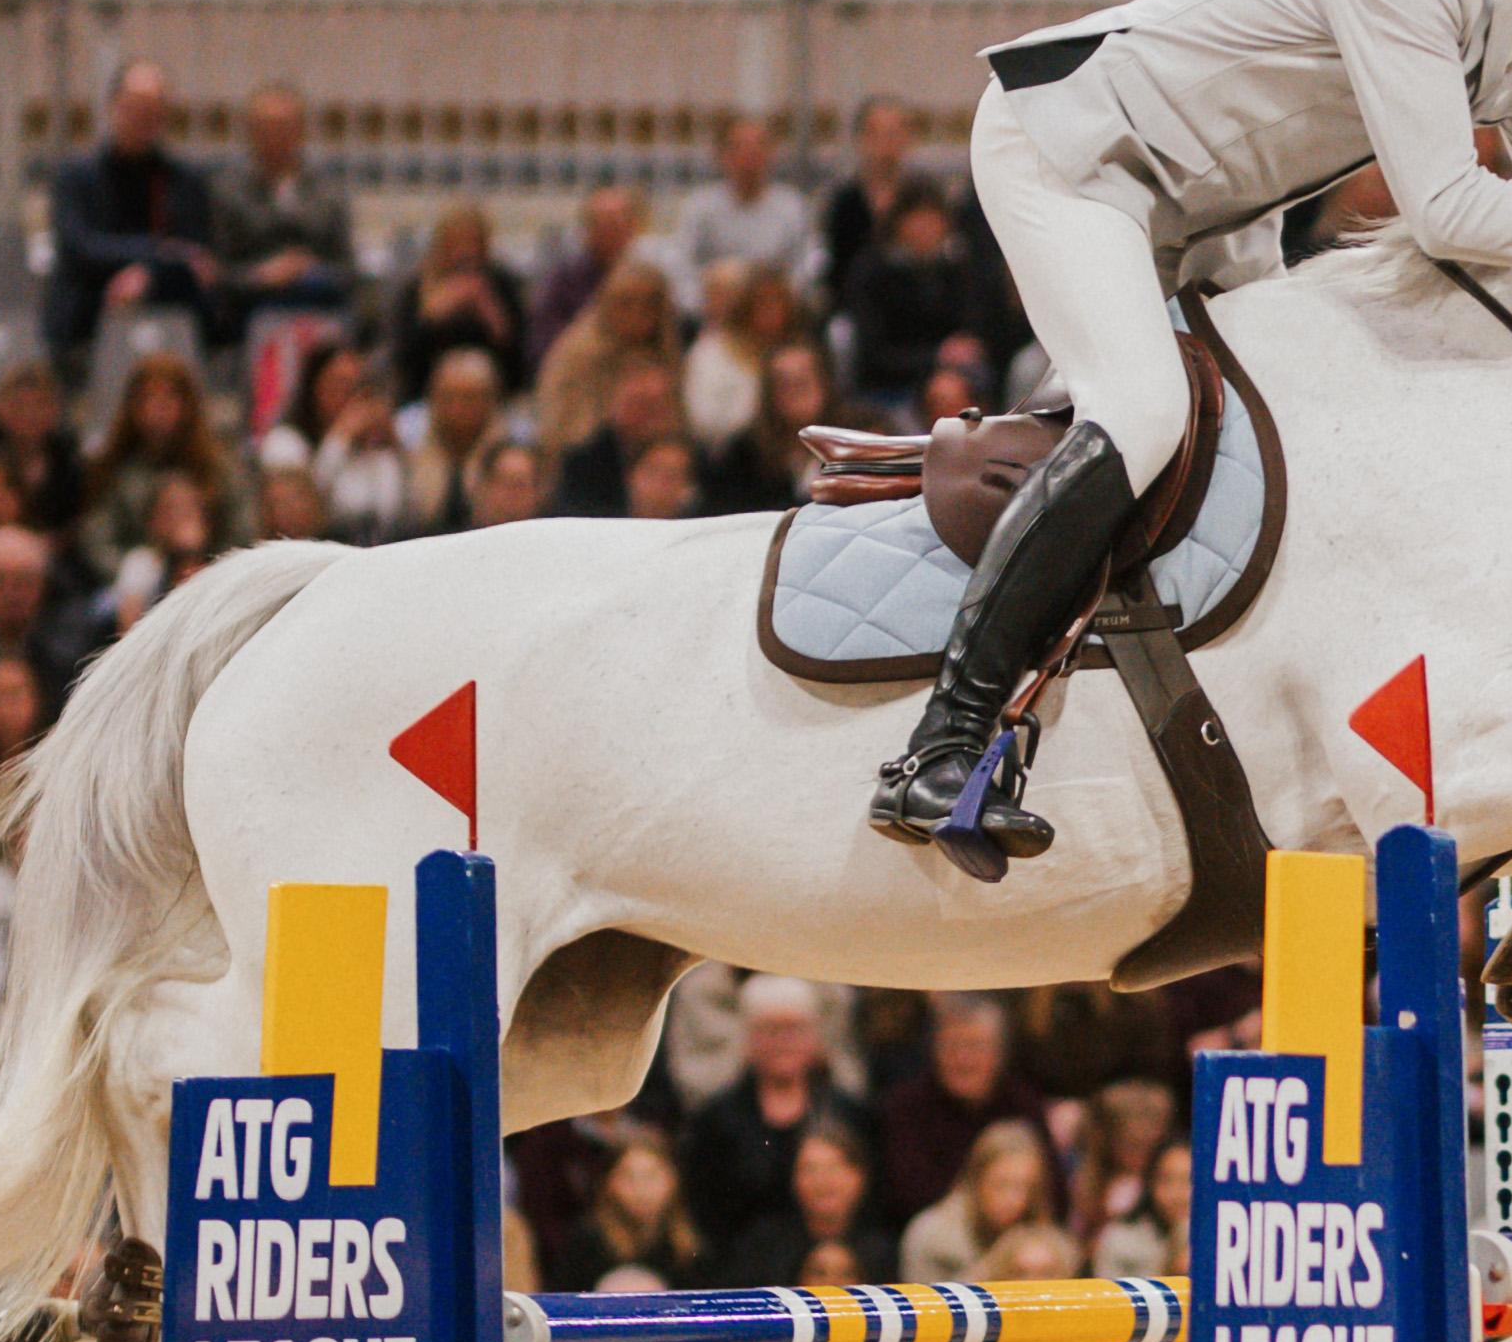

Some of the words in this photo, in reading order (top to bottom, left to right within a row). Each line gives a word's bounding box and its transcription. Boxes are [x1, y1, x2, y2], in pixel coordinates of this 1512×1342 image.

[194, 1097, 314, 1202] ATG
[1214, 1076, 1309, 1185] ATG
[195, 1217, 407, 1321] RIDERS
[1215, 1200, 1385, 1309] RIDERS
